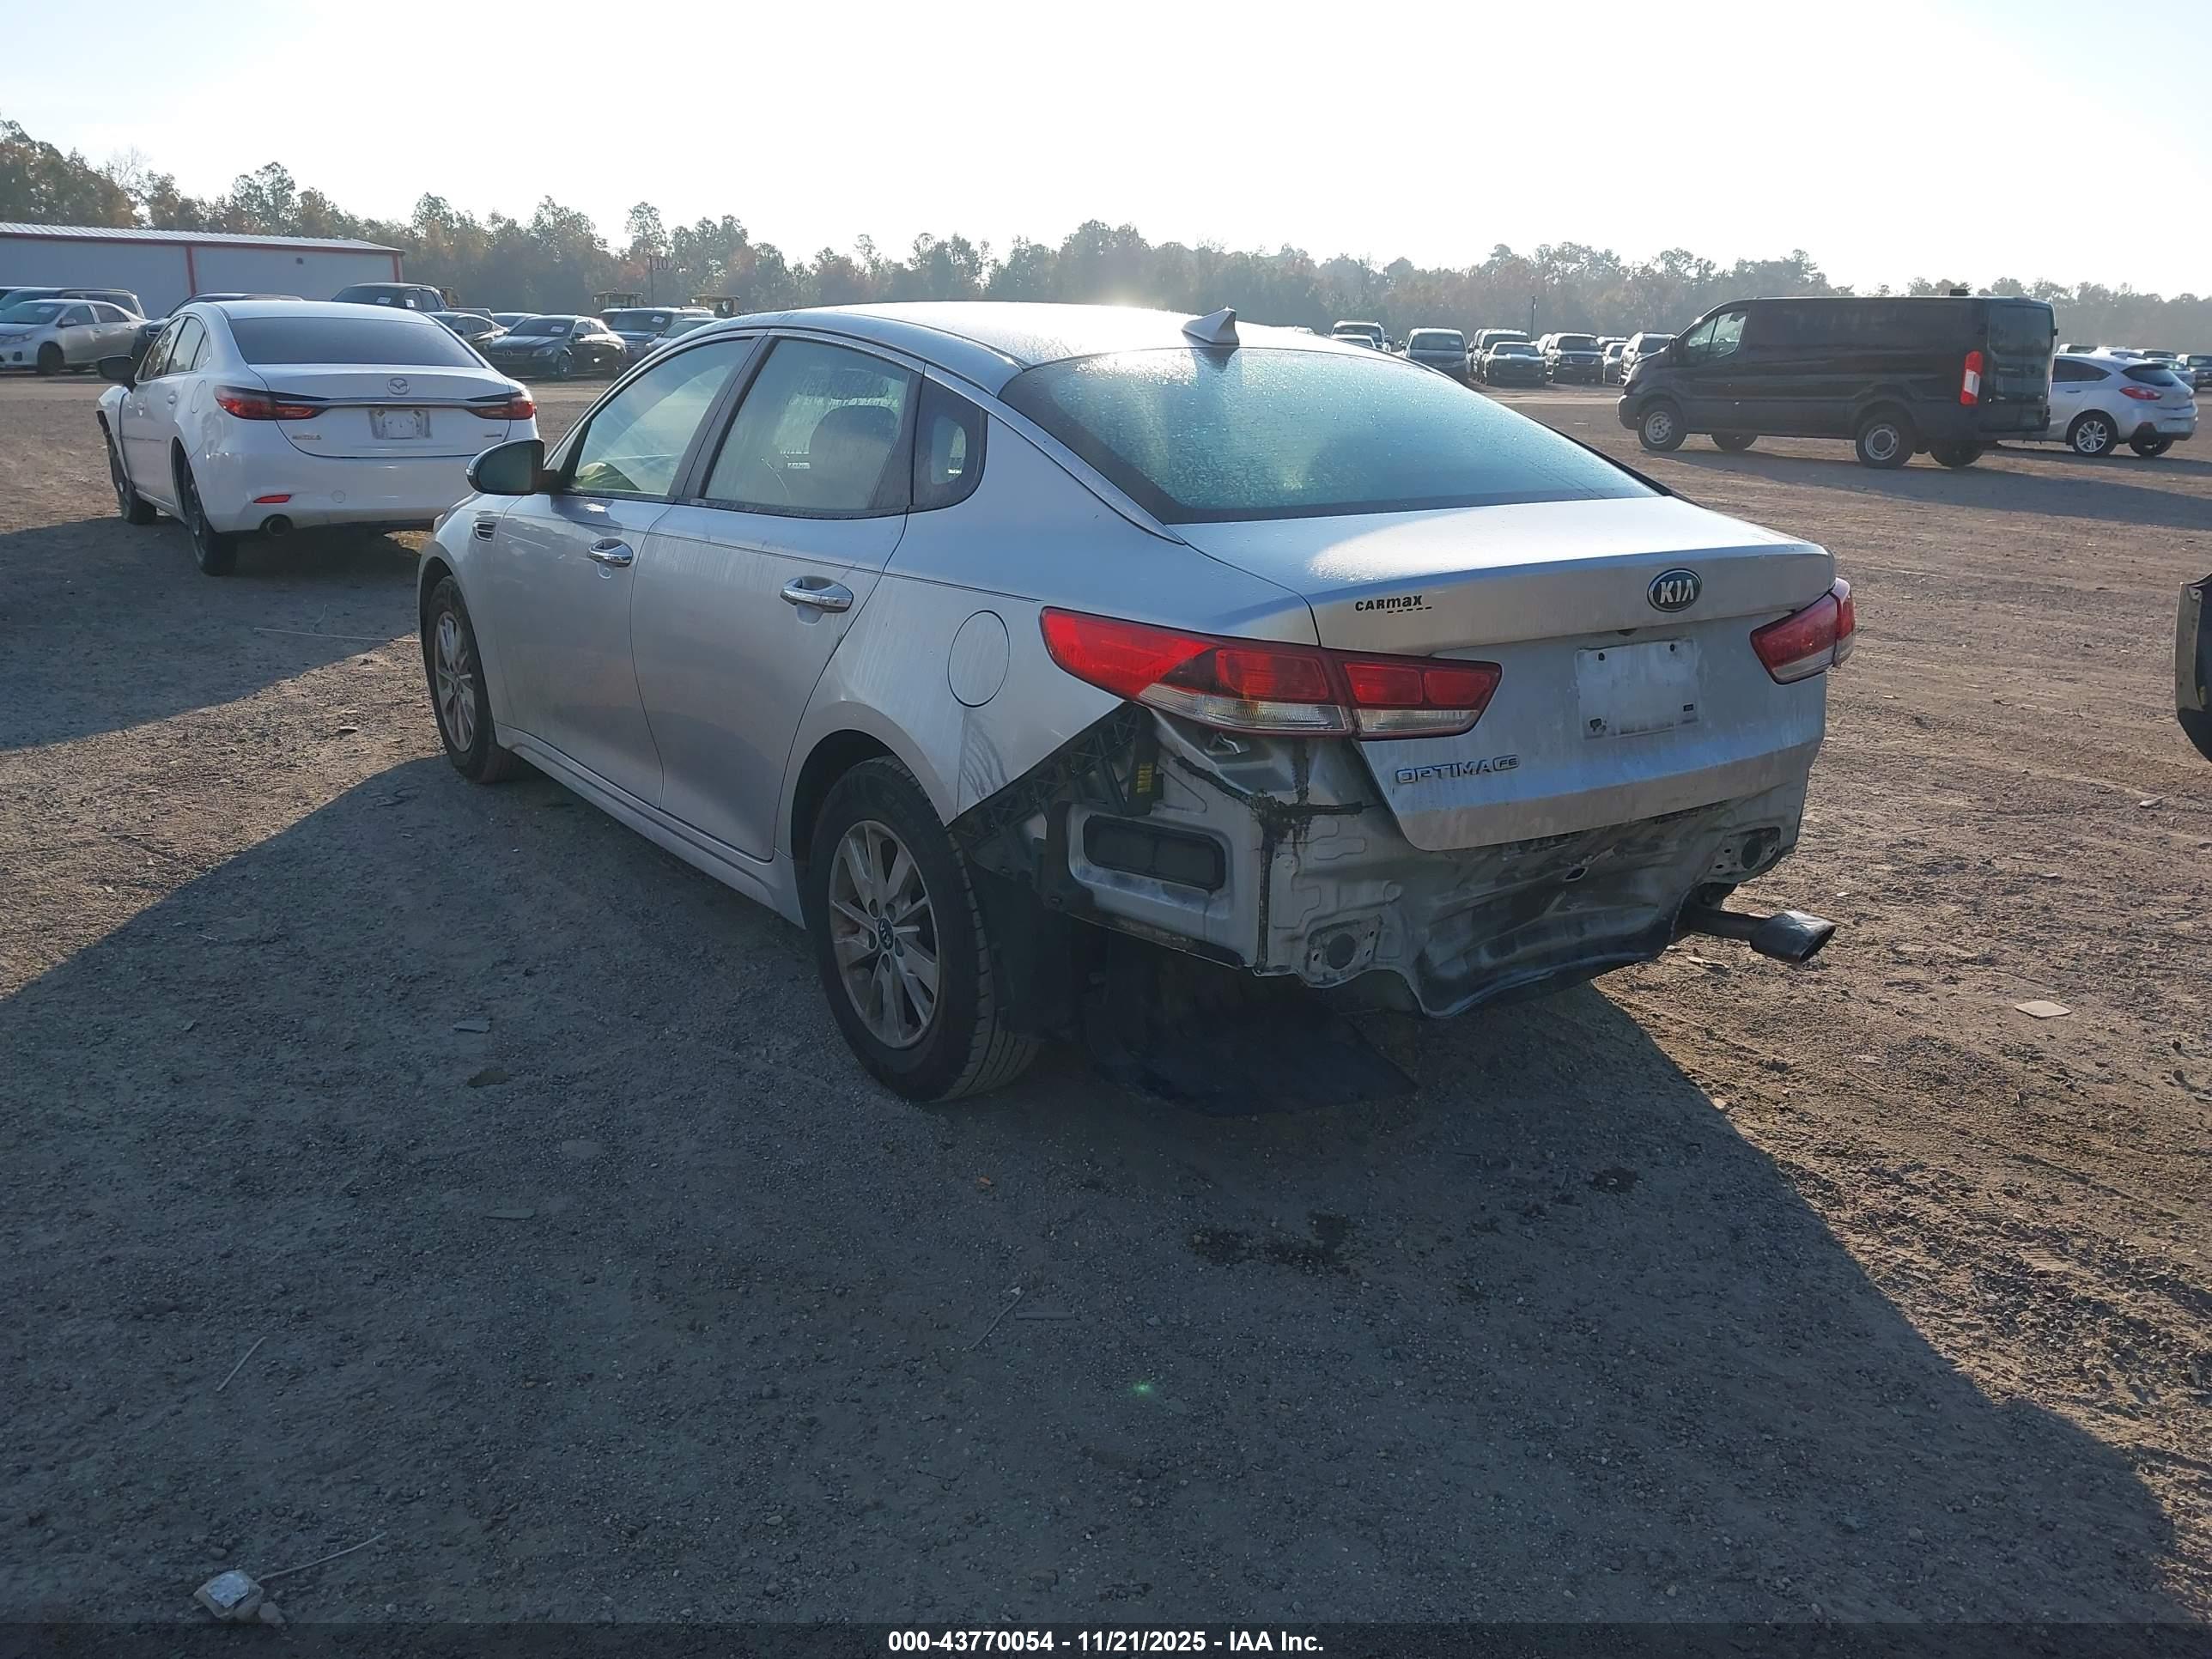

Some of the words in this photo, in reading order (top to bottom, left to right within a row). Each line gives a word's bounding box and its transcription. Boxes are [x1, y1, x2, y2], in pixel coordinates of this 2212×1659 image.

[1660, 579, 1694, 604] KIA
[1395, 759, 1492, 784] OPTIMA
[1497, 756, 1519, 770] FE
